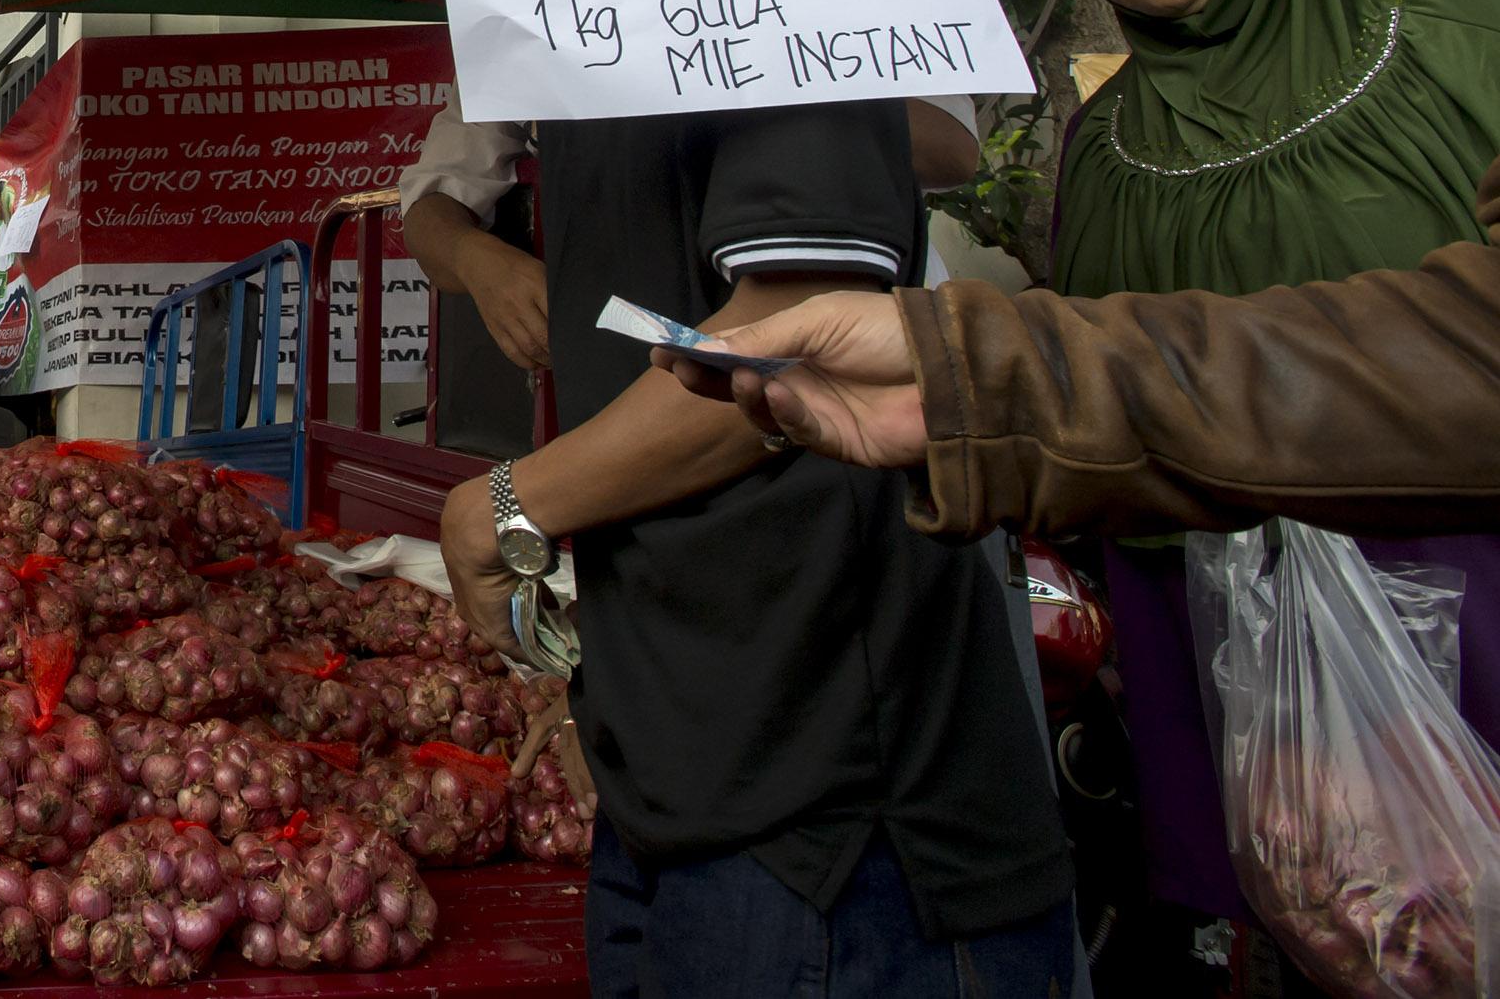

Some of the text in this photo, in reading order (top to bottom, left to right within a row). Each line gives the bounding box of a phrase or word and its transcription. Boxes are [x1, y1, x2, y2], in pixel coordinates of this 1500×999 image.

[122, 58, 389, 89] PASAR MURAH
[665, 22, 977, 95] MIE INSTANT
[75, 83, 452, 117] OKO TANI INDONESIA
[179, 133, 261, 159] Usaha
[271, 135, 370, 166] Pangan
[108, 170, 201, 193] TOKO
[209, 167, 297, 191] TANI
[87, 202, 197, 228] Stabilisasi
[200, 200, 293, 227] Pasokan
[40, 287, 73, 312] PETANI
